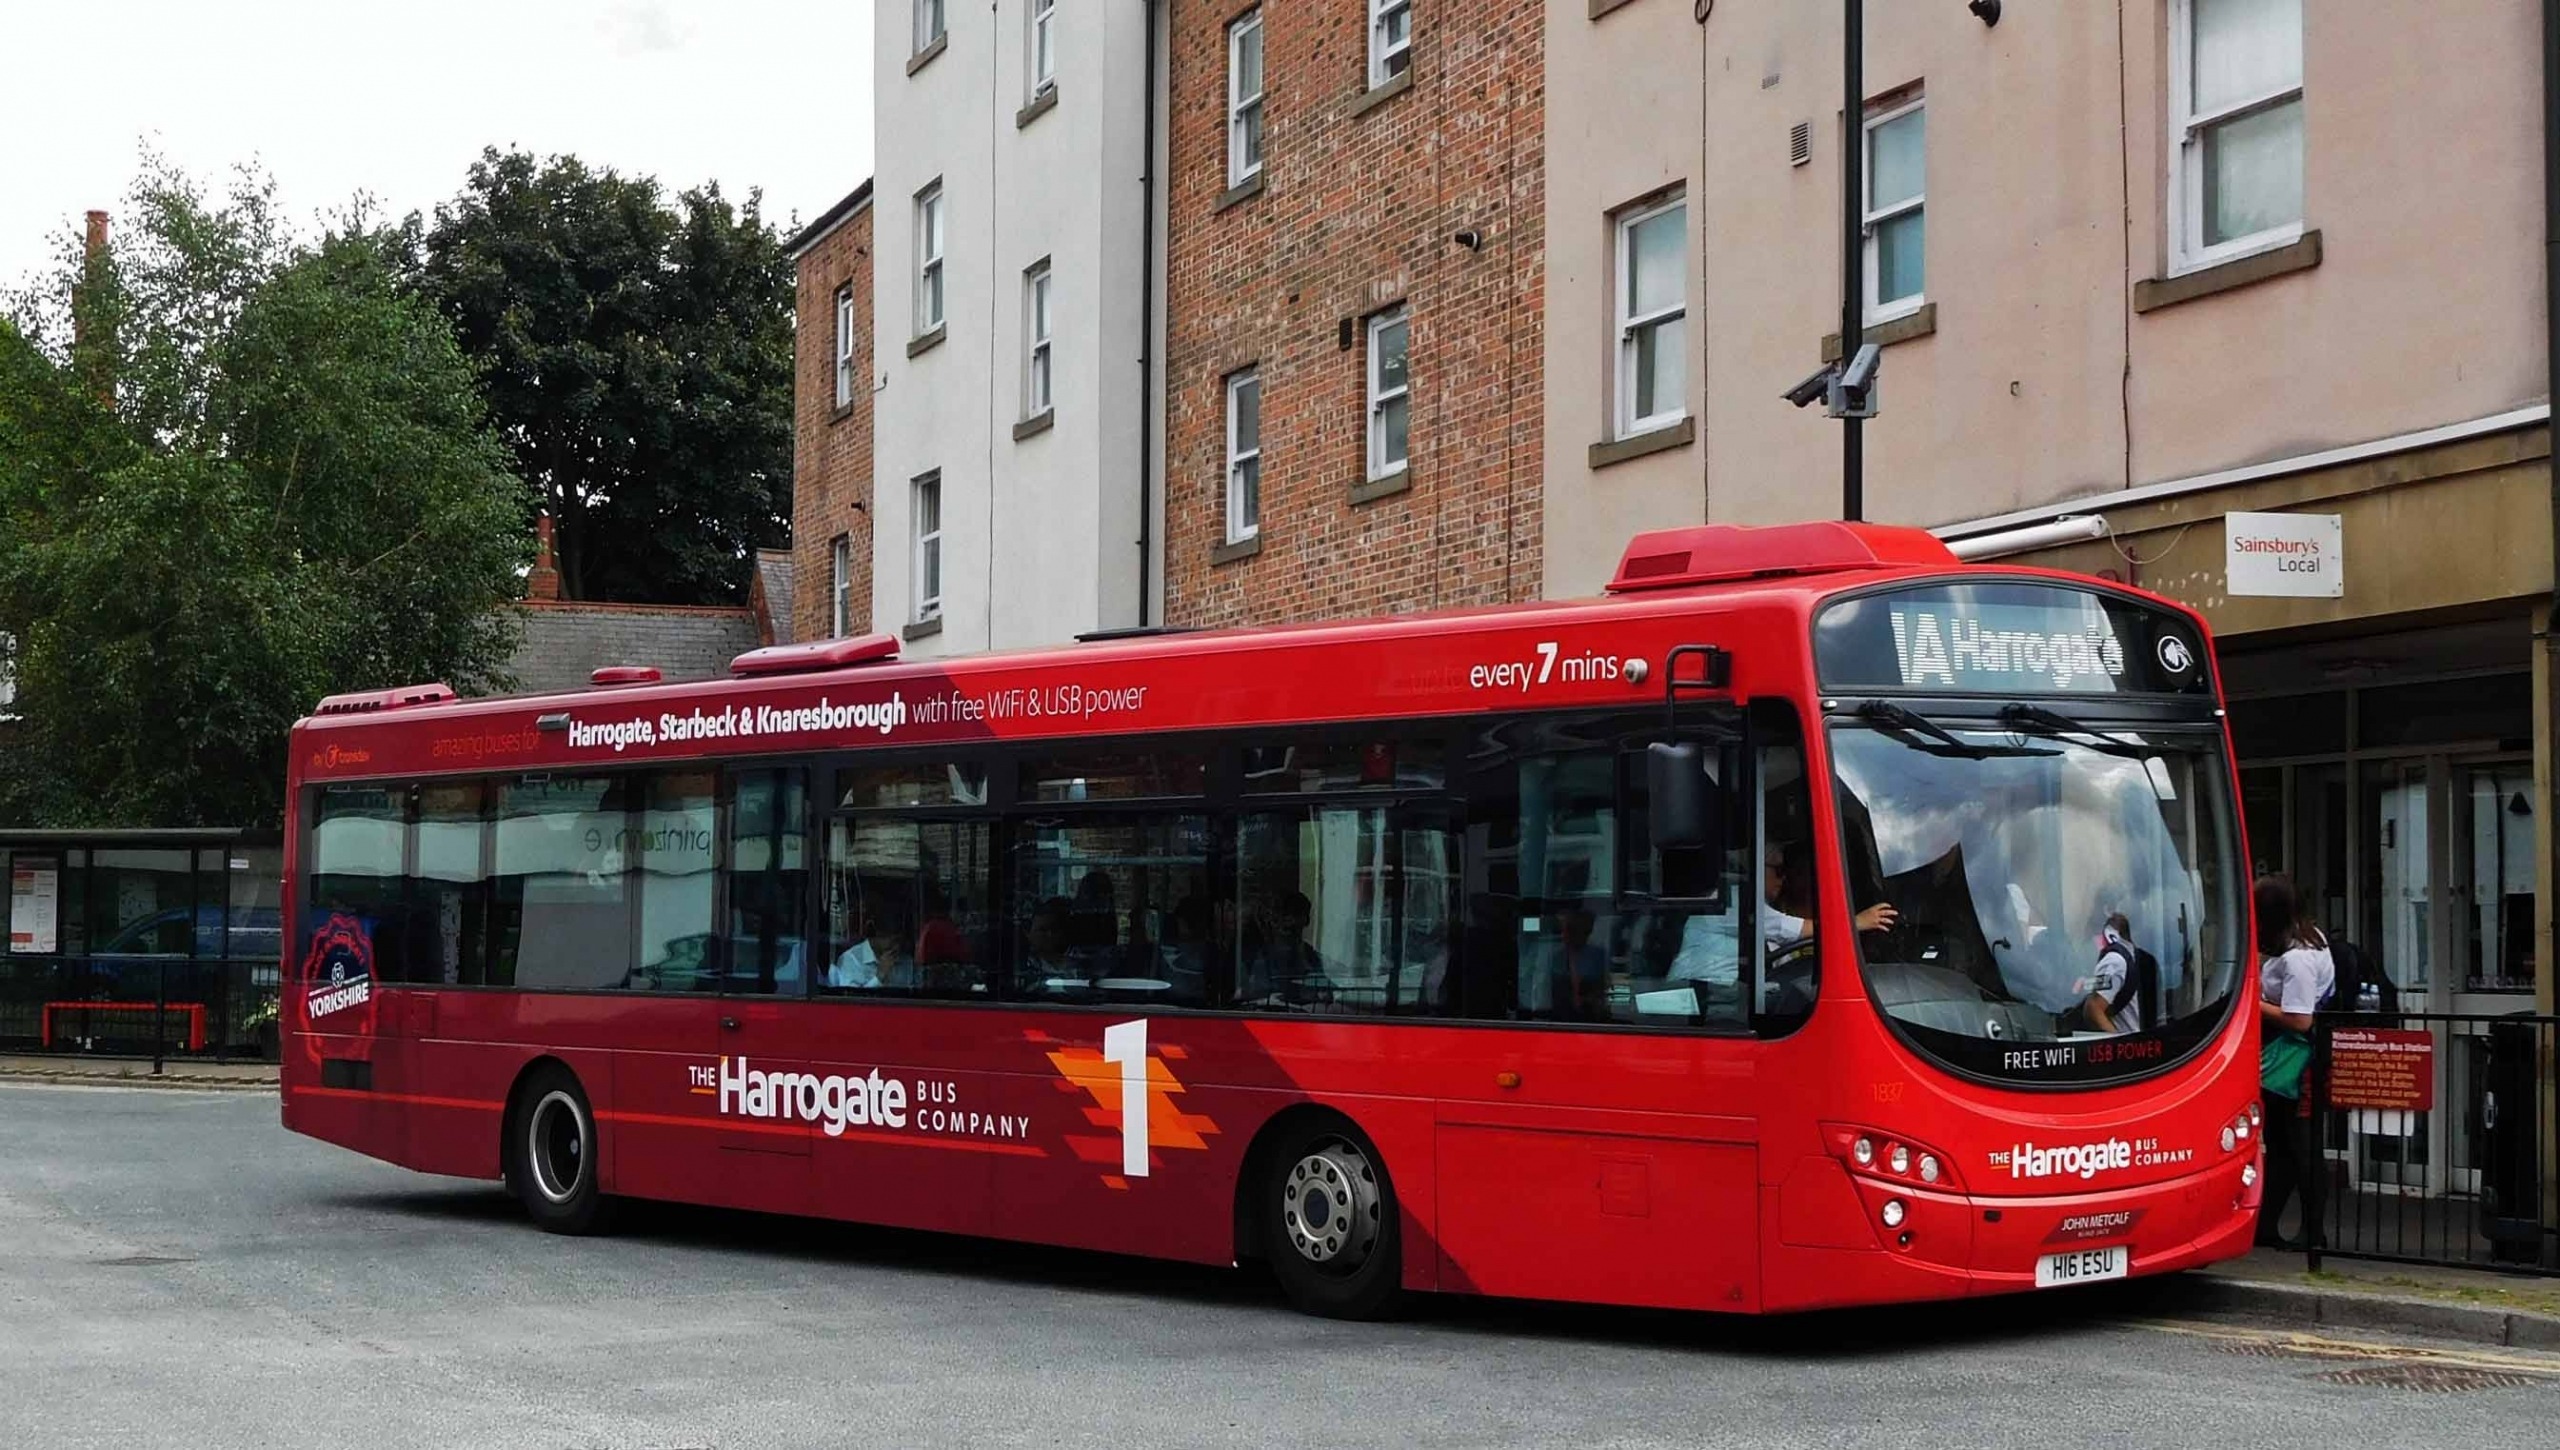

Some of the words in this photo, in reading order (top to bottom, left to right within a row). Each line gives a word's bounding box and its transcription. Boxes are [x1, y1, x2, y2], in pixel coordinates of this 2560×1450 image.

[2234, 536, 2319, 557] Sainsbury's
[2278, 555, 2320, 572] Local
[1891, 612, 1955, 684] 1A
[1951, 619, 2125, 688] Harrogate
[1469, 661, 1534, 692] every
[1537, 642, 1558, 683] 7
[1562, 650, 1618, 682] mins
[432, 733, 483, 760] amazing
[484, 730, 521, 753] buses
[568, 716, 656, 751] Harrogate,
[659, 705, 737, 741] Starbeck
[739, 707, 754, 734] &
[757, 692, 906, 734] Knaresborough
[912, 691, 948, 724] with
[951, 690, 985, 721] free
[988, 689, 1024, 718] WiFi
[1027, 688, 1042, 716] &
[1045, 685, 1082, 715] USB
[1085, 687, 1147, 720] power
[308, 981, 370, 1019] YORKSHIRE
[2004, 1050, 2040, 1070] FREE
[2044, 1047, 2076, 1067] WIFI
[2087, 1044, 2113, 1063] USB
[2116, 1041, 2163, 1060] POWER
[688, 1065, 716, 1087] THE
[720, 1055, 907, 1136] Harrogate
[917, 1080, 956, 1103] BUS
[1104, 1018, 1150, 1177] 1
[1871, 1082, 1904, 1103] 1837
[917, 1109, 1029, 1138] COMPANY
[1988, 1151, 2010, 1164] THE
[2012, 1137, 2131, 1179] Harrogate
[2135, 1138, 2158, 1151] BUS
[2135, 1149, 2193, 1166] COMPANY
[2061, 1216, 2089, 1231] JOHN
[2089, 1212, 2130, 1228] METCALF
[2053, 1254, 2078, 1280] H16
[2083, 1249, 2114, 1276] ESU
